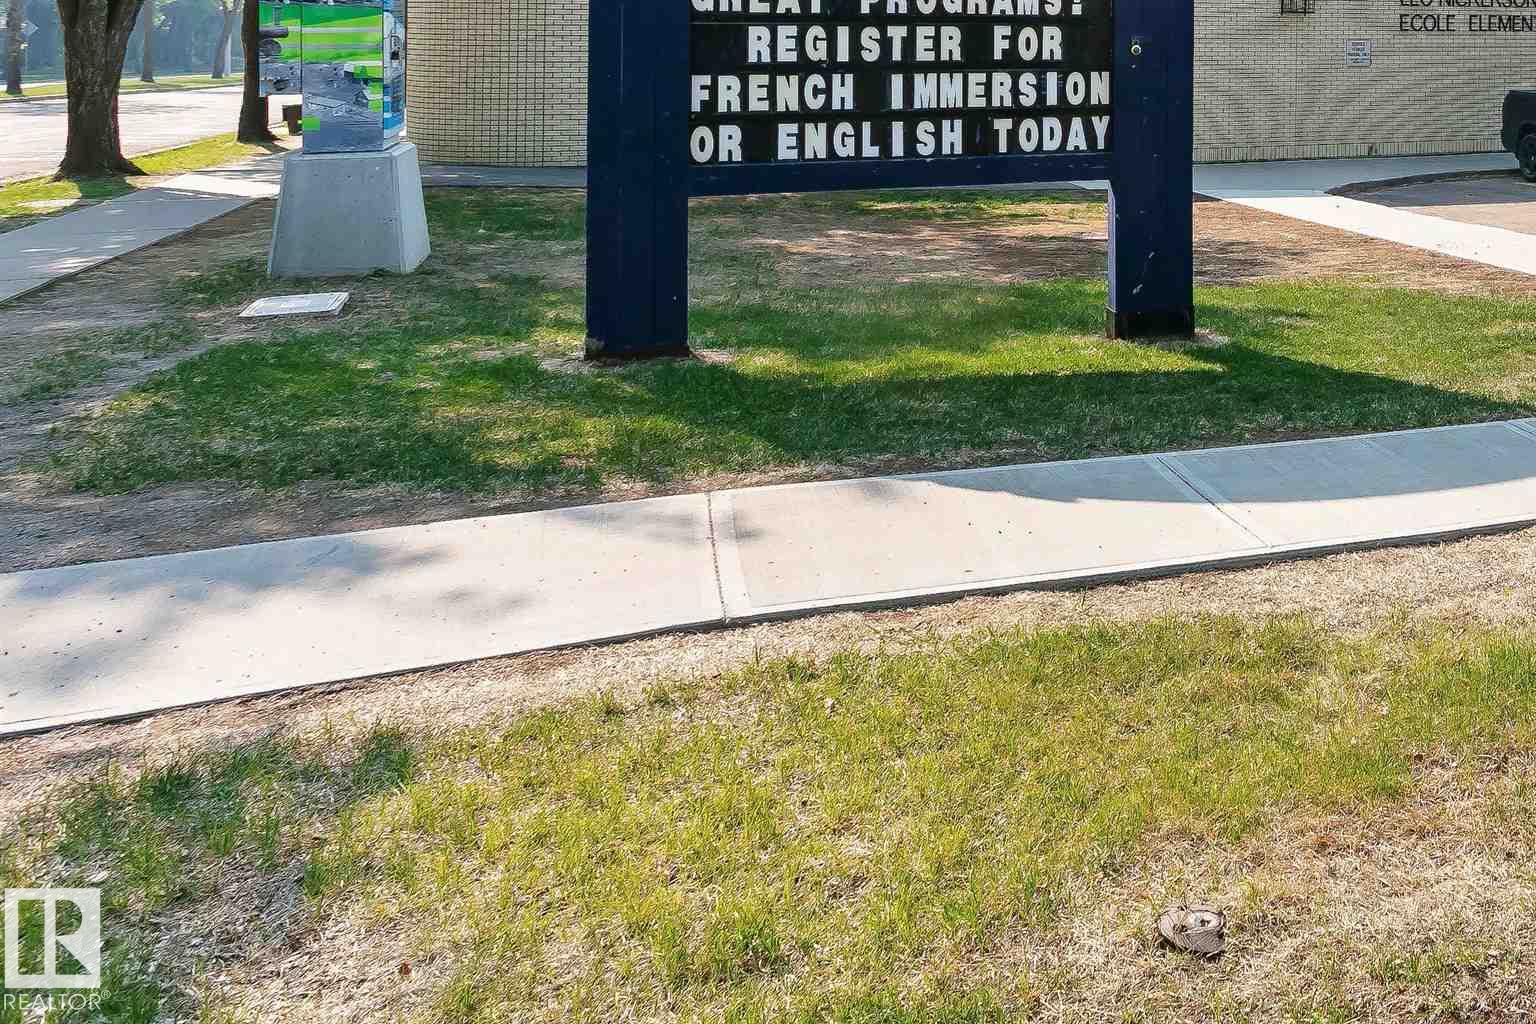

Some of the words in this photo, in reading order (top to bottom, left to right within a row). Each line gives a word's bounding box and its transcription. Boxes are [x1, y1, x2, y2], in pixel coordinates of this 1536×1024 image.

[1400, 14, 1455, 32] ECOLE
[748, 25, 962, 63] REGISTER
[993, 26, 1063, 61] FOR
[690, 73, 855, 112] FRENCH
[891, 71, 1110, 110] IMMERSION
[689, 125, 743, 162] OR
[777, 119, 964, 161] ENGLISH
[993, 116, 1110, 154] TODAY
